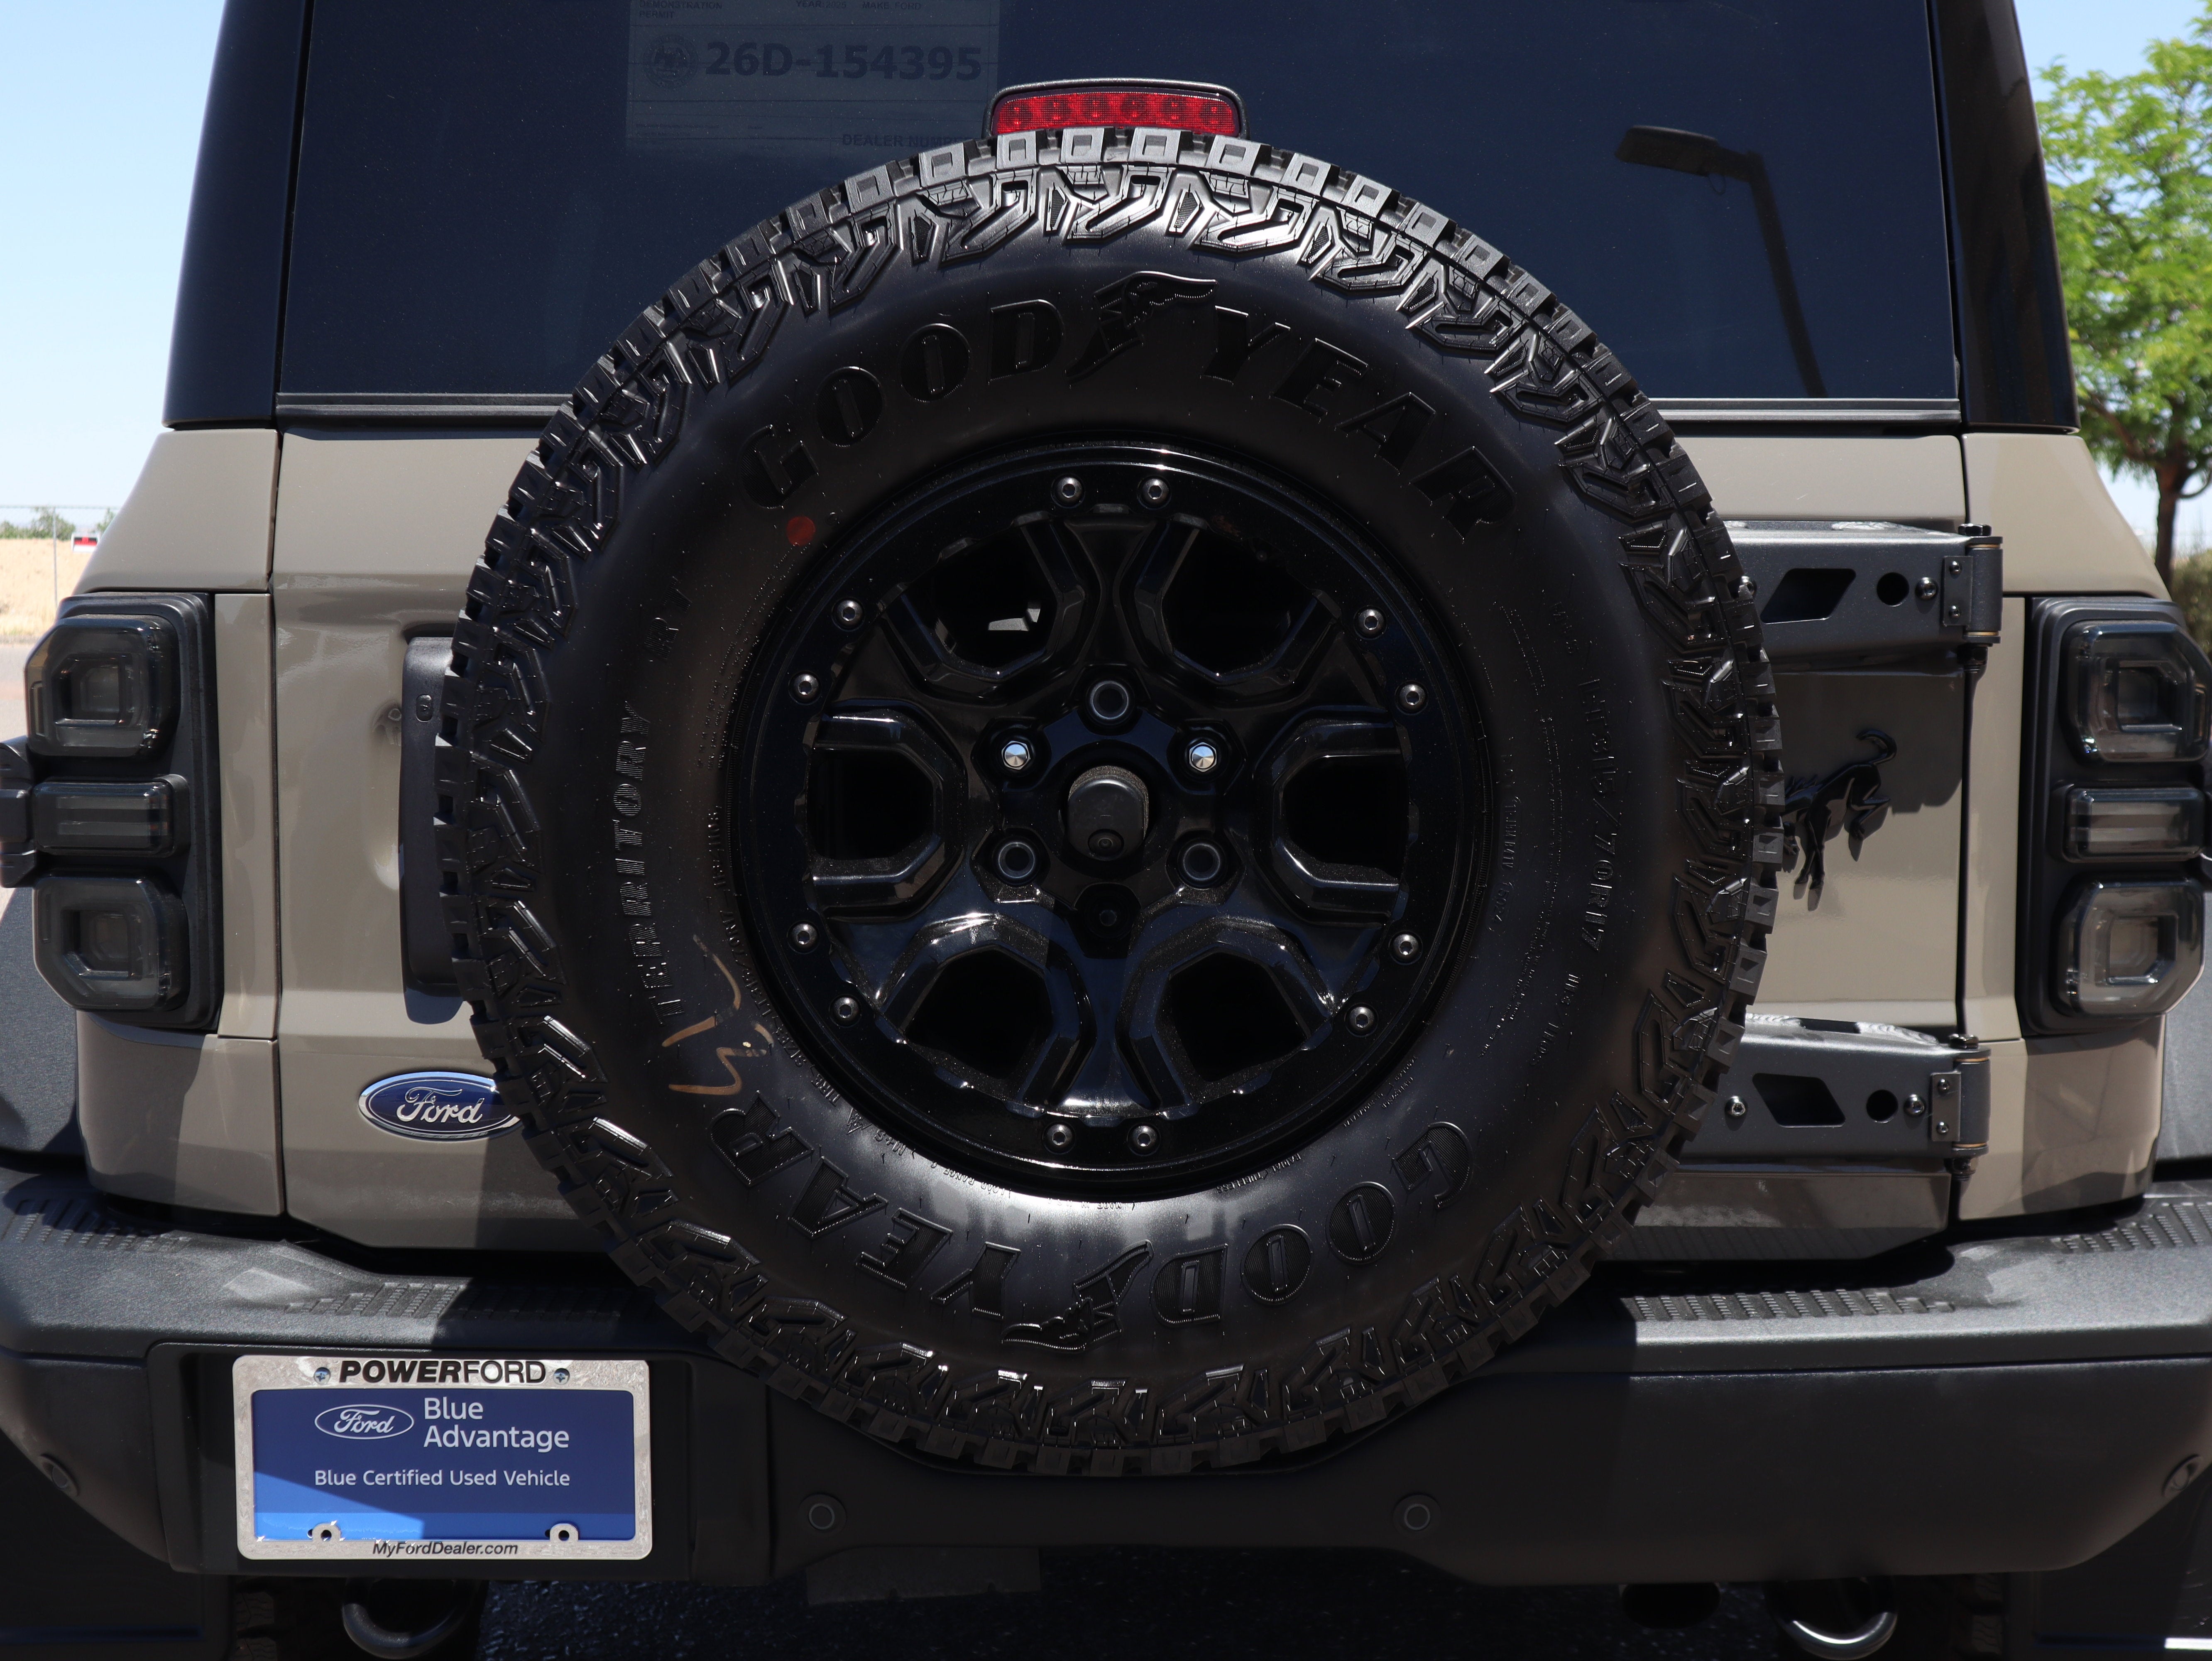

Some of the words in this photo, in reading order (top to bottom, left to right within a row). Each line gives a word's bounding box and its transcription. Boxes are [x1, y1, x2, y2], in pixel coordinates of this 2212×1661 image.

[705, 40, 982, 81] 26D-154395
[842, 134, 903, 147] DEALER
[643, 577, 695, 661] RT
[613, 702, 684, 1024] TERRITORY
[1490, 887, 1510, 926] 5024
[810, 1072, 839, 1107] TIRE
[396, 1086, 485, 1124] Ford
[1271, 1153, 1301, 1173] RADIAL
[1216, 1172, 1263, 1194] TUBELESS
[339, 1360, 546, 1384] POWERFORD
[333, 1408, 396, 1435] Ford
[424, 1396, 484, 1421] Blue
[423, 1425, 570, 1453] Advantage
[315, 1470, 356, 1486] Blue
[363, 1470, 443, 1487] Certified
[450, 1470, 497, 1487] Used
[503, 1470, 571, 1487] Vehicle
[372, 1541, 518, 1556] MyFordDealer.com
